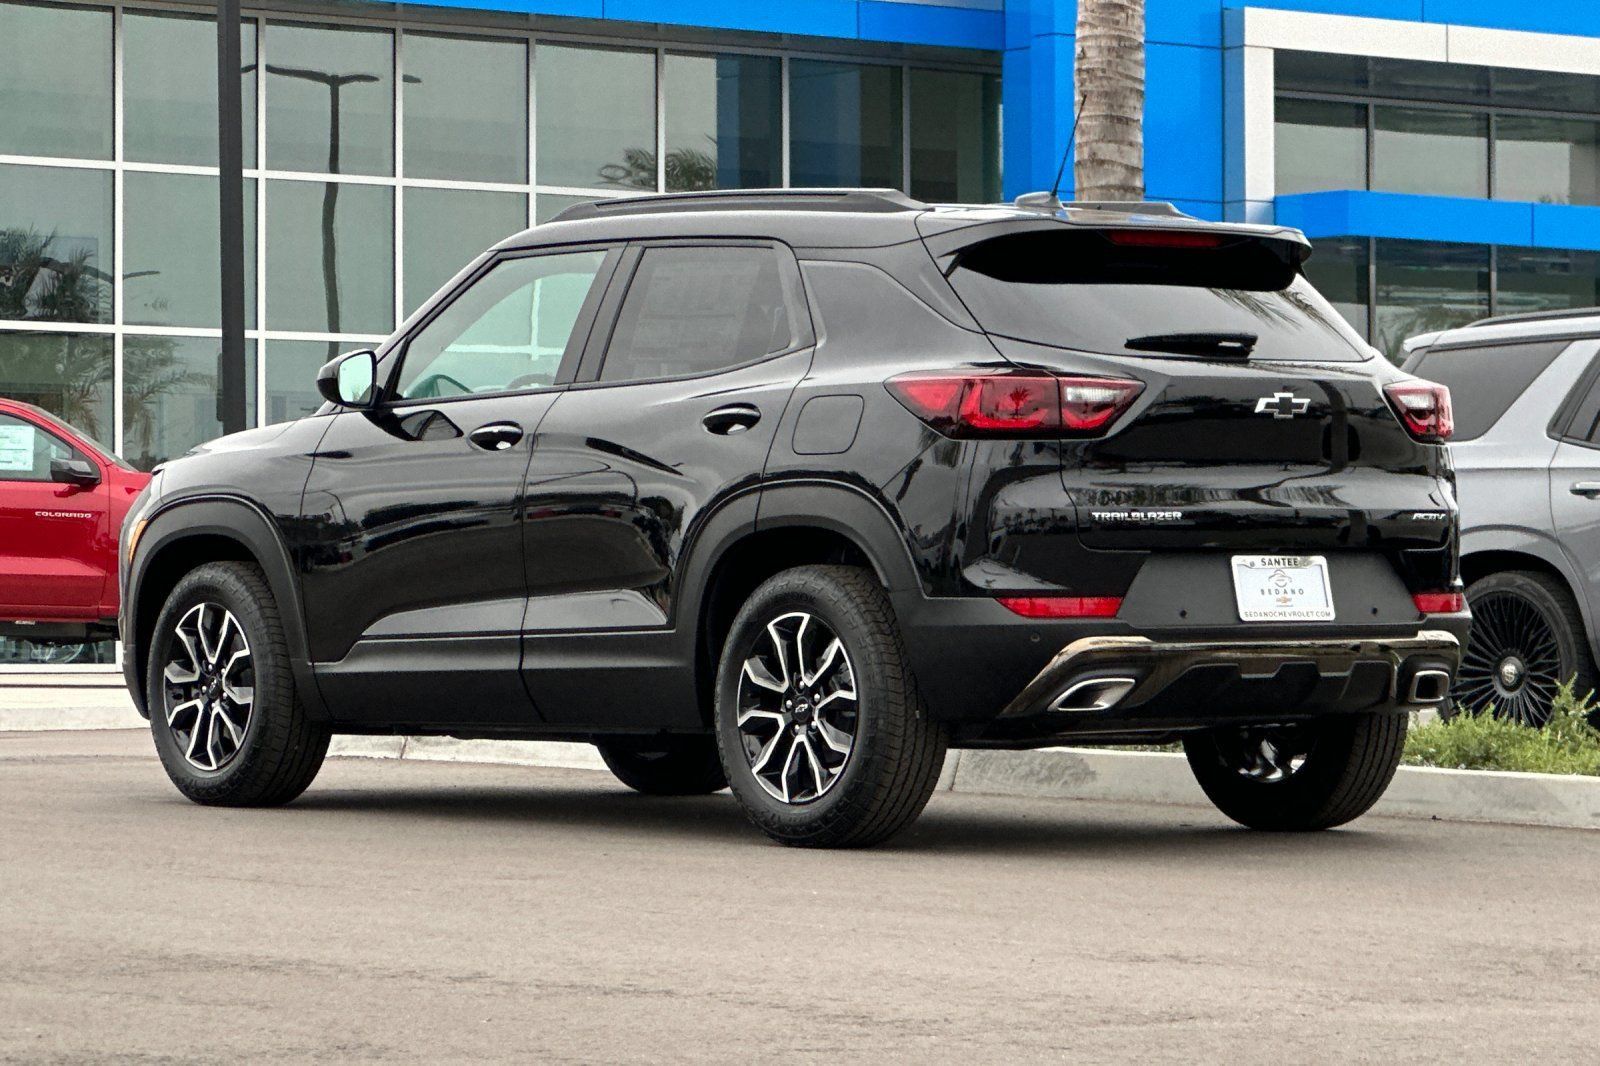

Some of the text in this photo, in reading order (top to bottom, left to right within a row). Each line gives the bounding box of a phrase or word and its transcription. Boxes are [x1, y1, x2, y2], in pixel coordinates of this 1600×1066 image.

[1092, 511, 1182, 521] TRAILBLAZER
[1412, 512, 1446, 520] ACTIV
[1261, 557, 1298, 566] SANTEE
